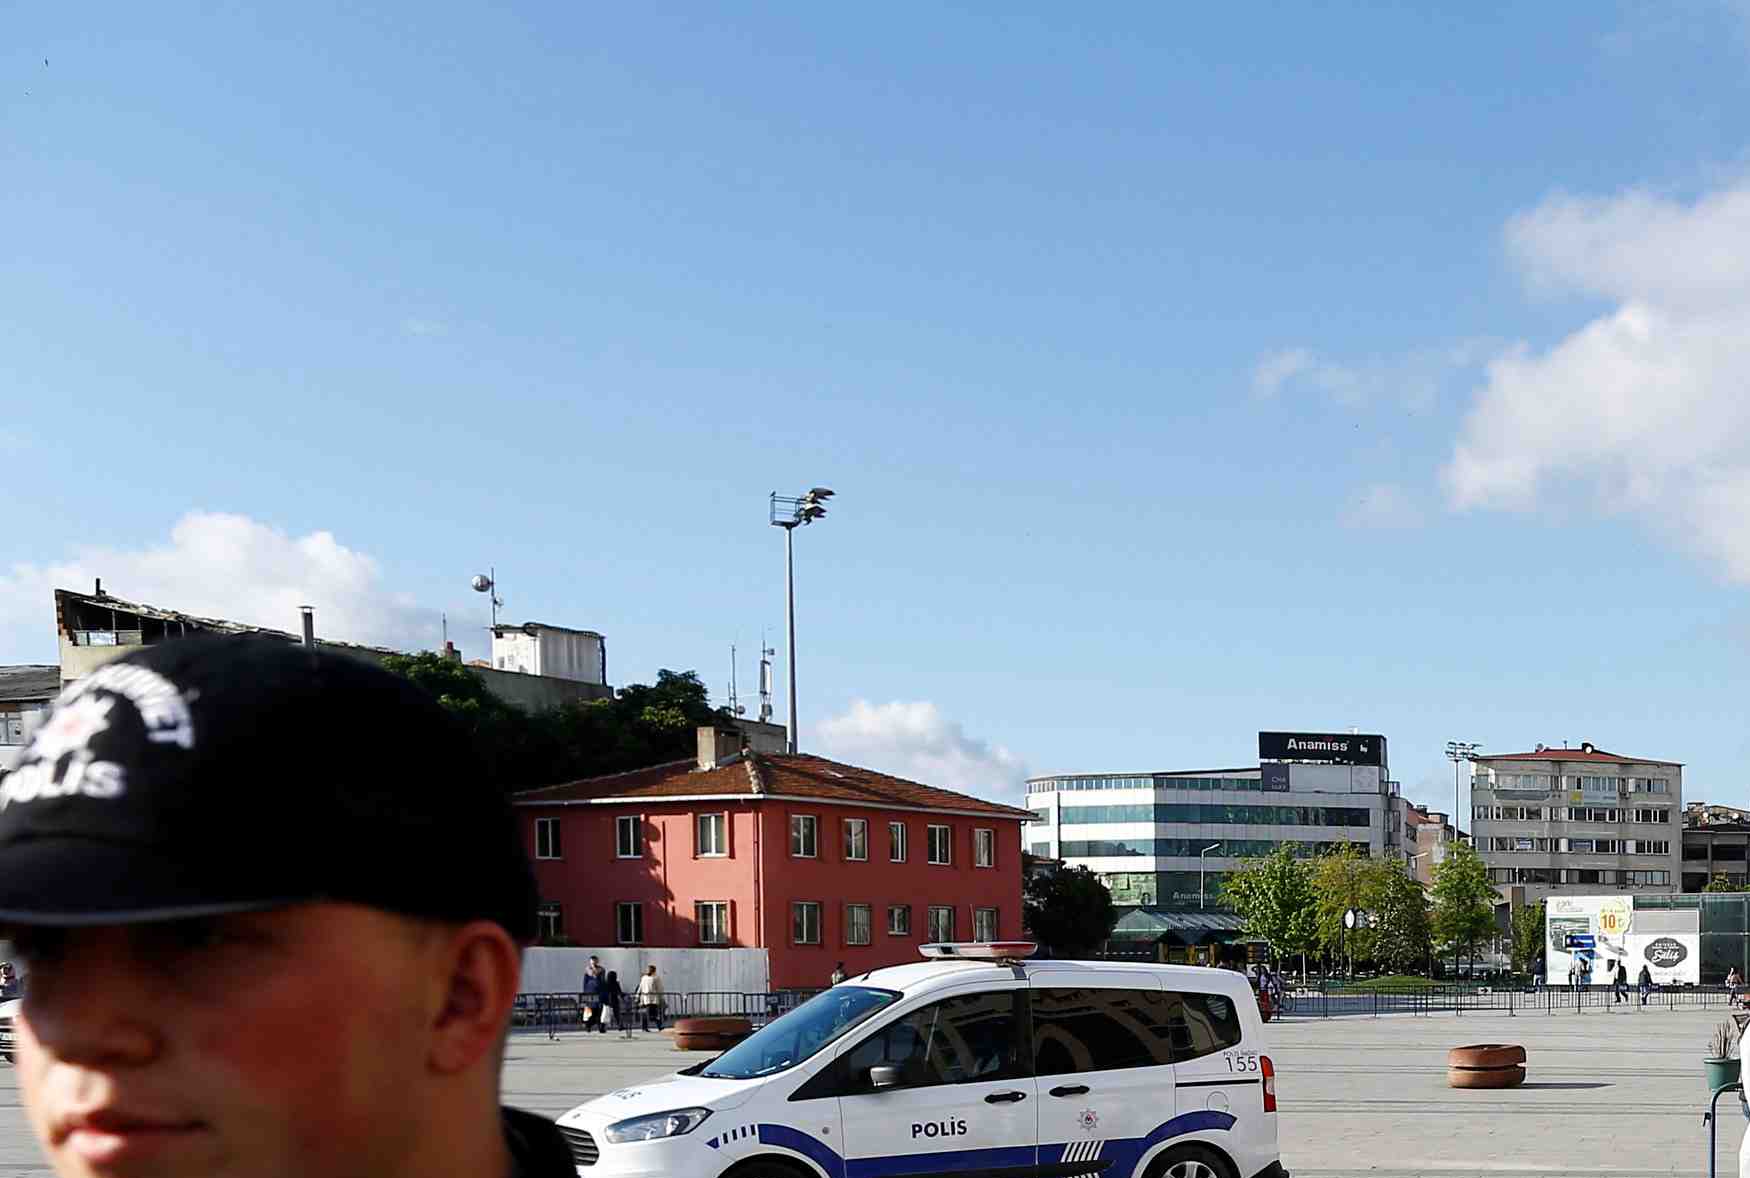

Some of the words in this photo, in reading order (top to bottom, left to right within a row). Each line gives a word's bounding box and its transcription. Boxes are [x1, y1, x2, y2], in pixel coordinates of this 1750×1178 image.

[1287, 738, 1348, 752] Anamiss
[1225, 1055, 1258, 1072] 155
[911, 1116, 968, 1138] POLİS
